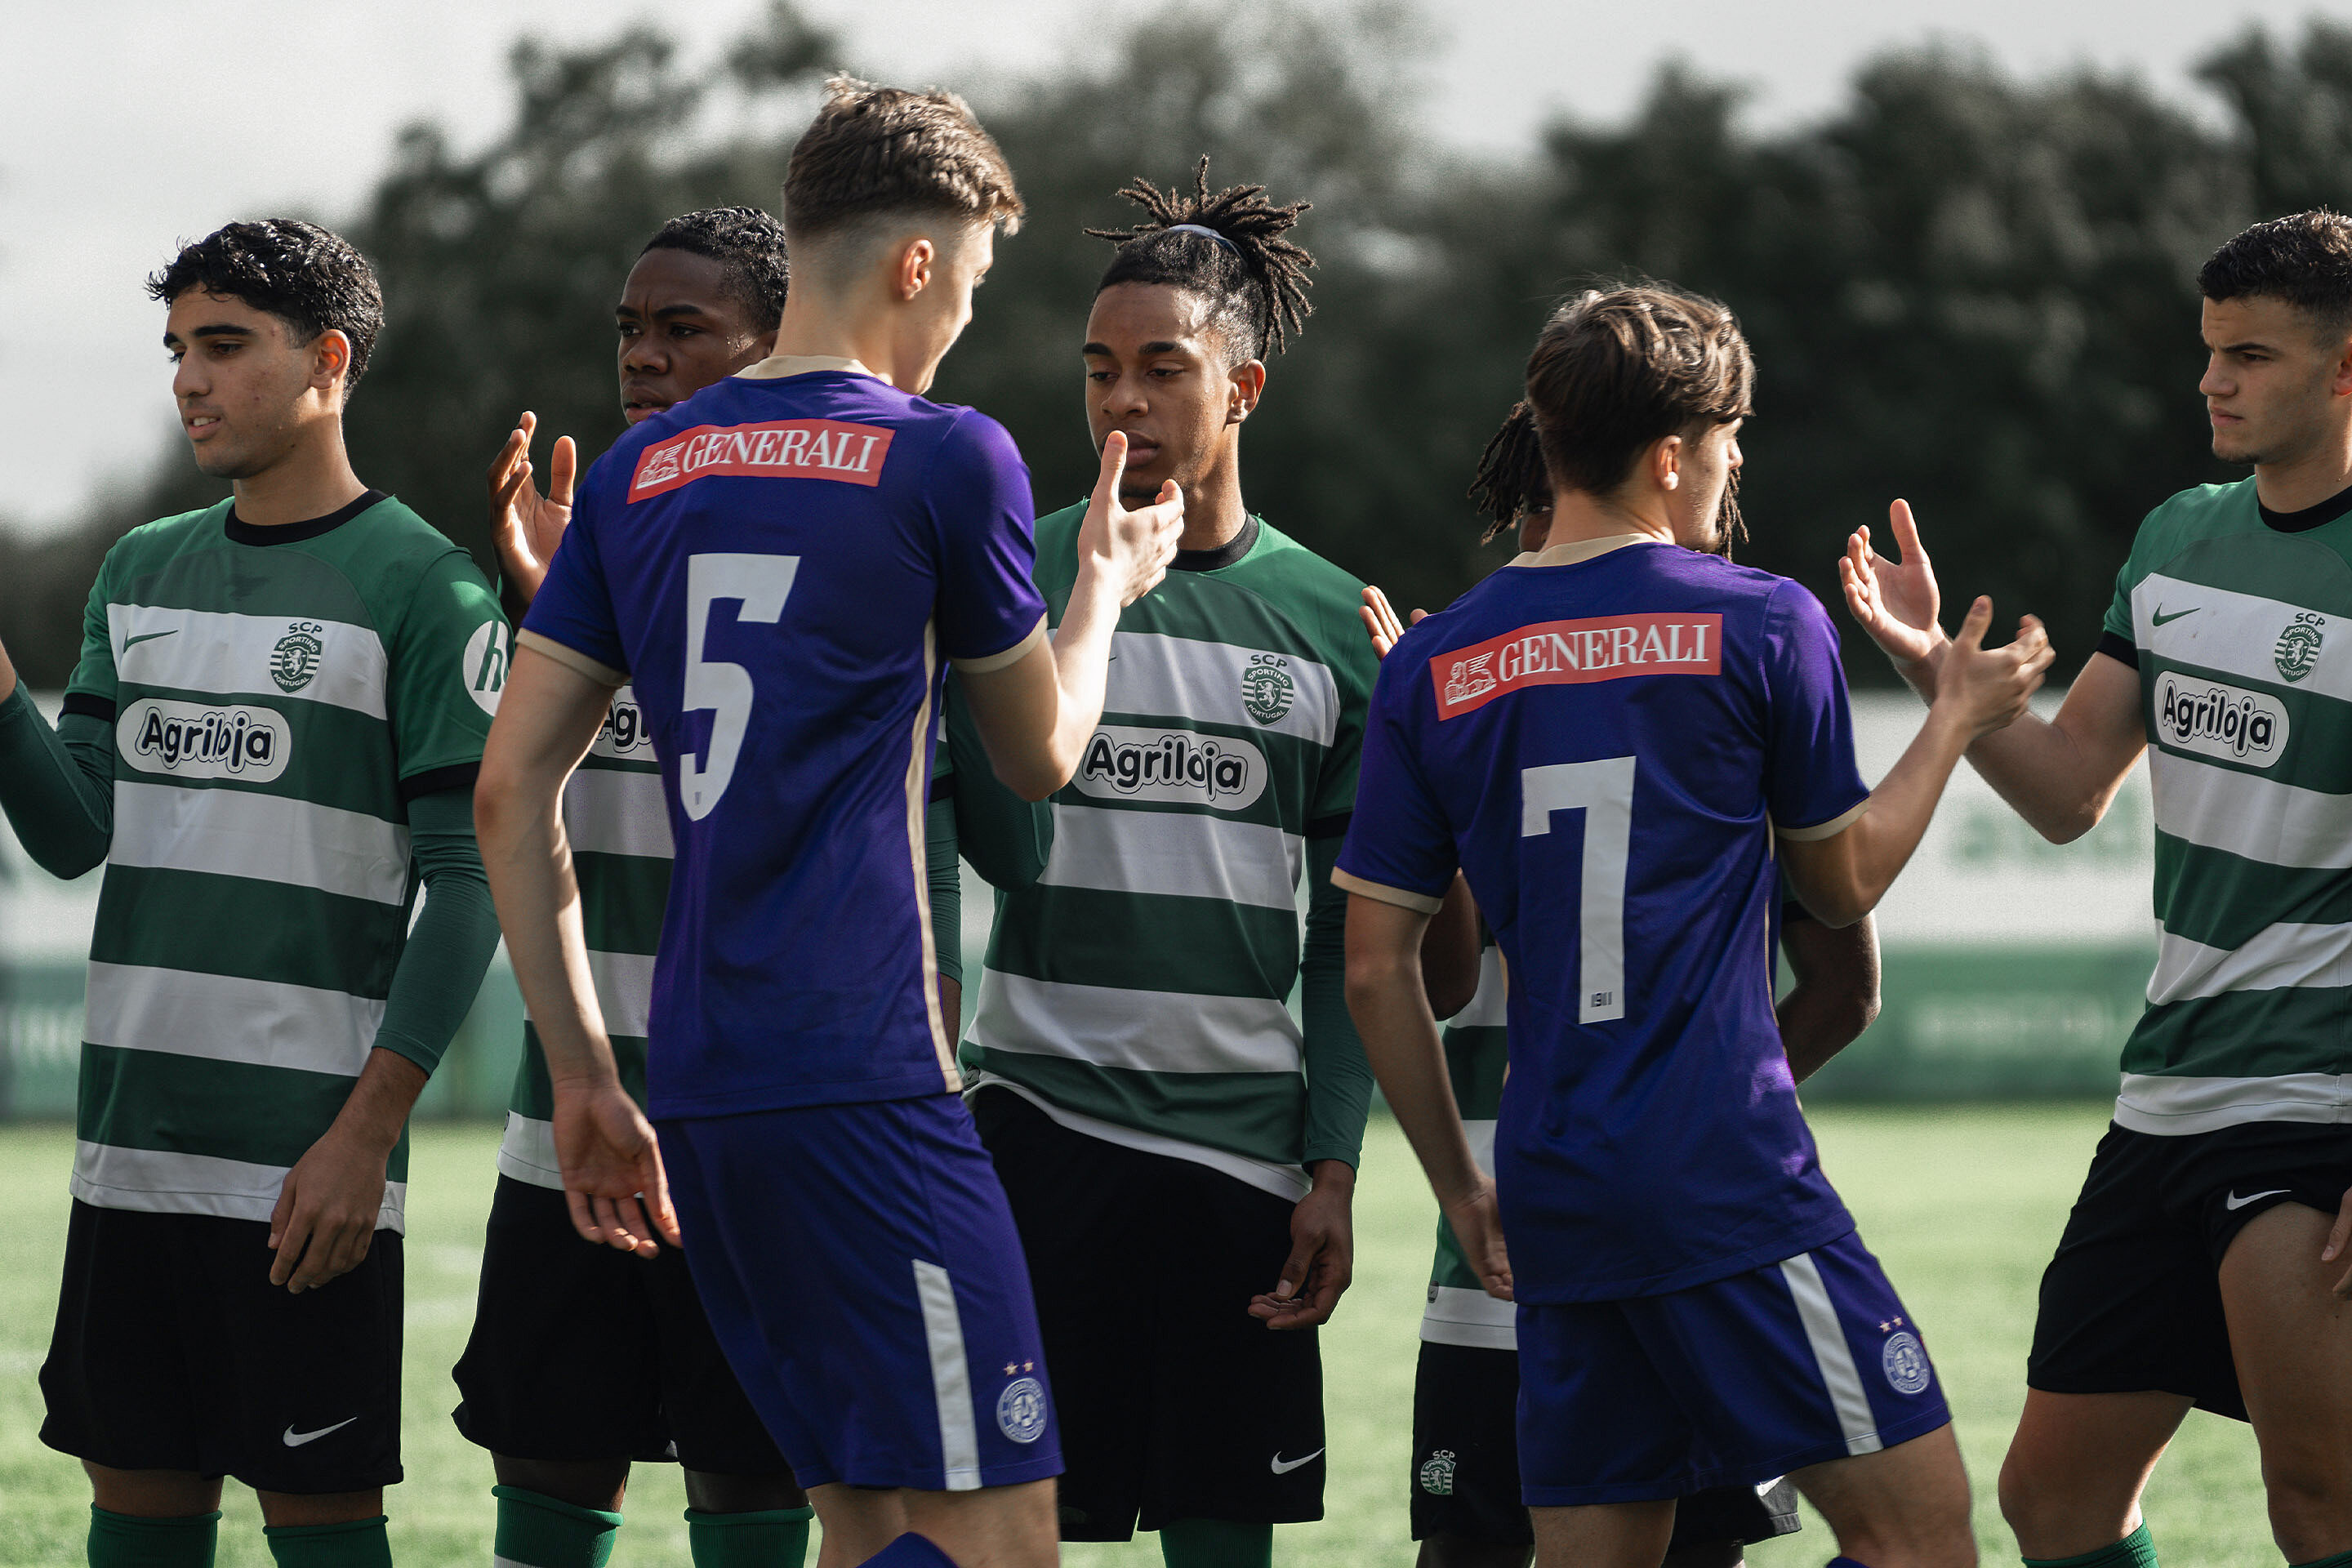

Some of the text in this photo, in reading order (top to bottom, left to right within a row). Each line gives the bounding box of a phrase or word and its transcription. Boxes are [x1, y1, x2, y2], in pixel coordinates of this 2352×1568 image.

[682, 429, 880, 474] GENERALI
[288, 621, 323, 634] SCP
[2295, 612, 2325, 626] SCP
[278, 636, 318, 653] SPORTING
[2284, 626, 2319, 645] SPORTING
[474, 621, 509, 693] h
[1250, 654, 1288, 668] SCP
[1499, 624, 1712, 683] GENERALI
[1247, 668, 1290, 687] SPORTING
[2277, 661, 2309, 676] PORTUGAL
[273, 673, 310, 687] PORTUGAL
[679, 552, 801, 822] 5
[1248, 704, 1285, 719] PORTUGAL
[2163, 684, 2274, 752] Agriloja
[140, 710, 273, 769] Agriloja
[1085, 737, 1244, 795] Agriloja
[1521, 755, 1637, 1024] 7
[1432, 1450, 1455, 1459] SCP
